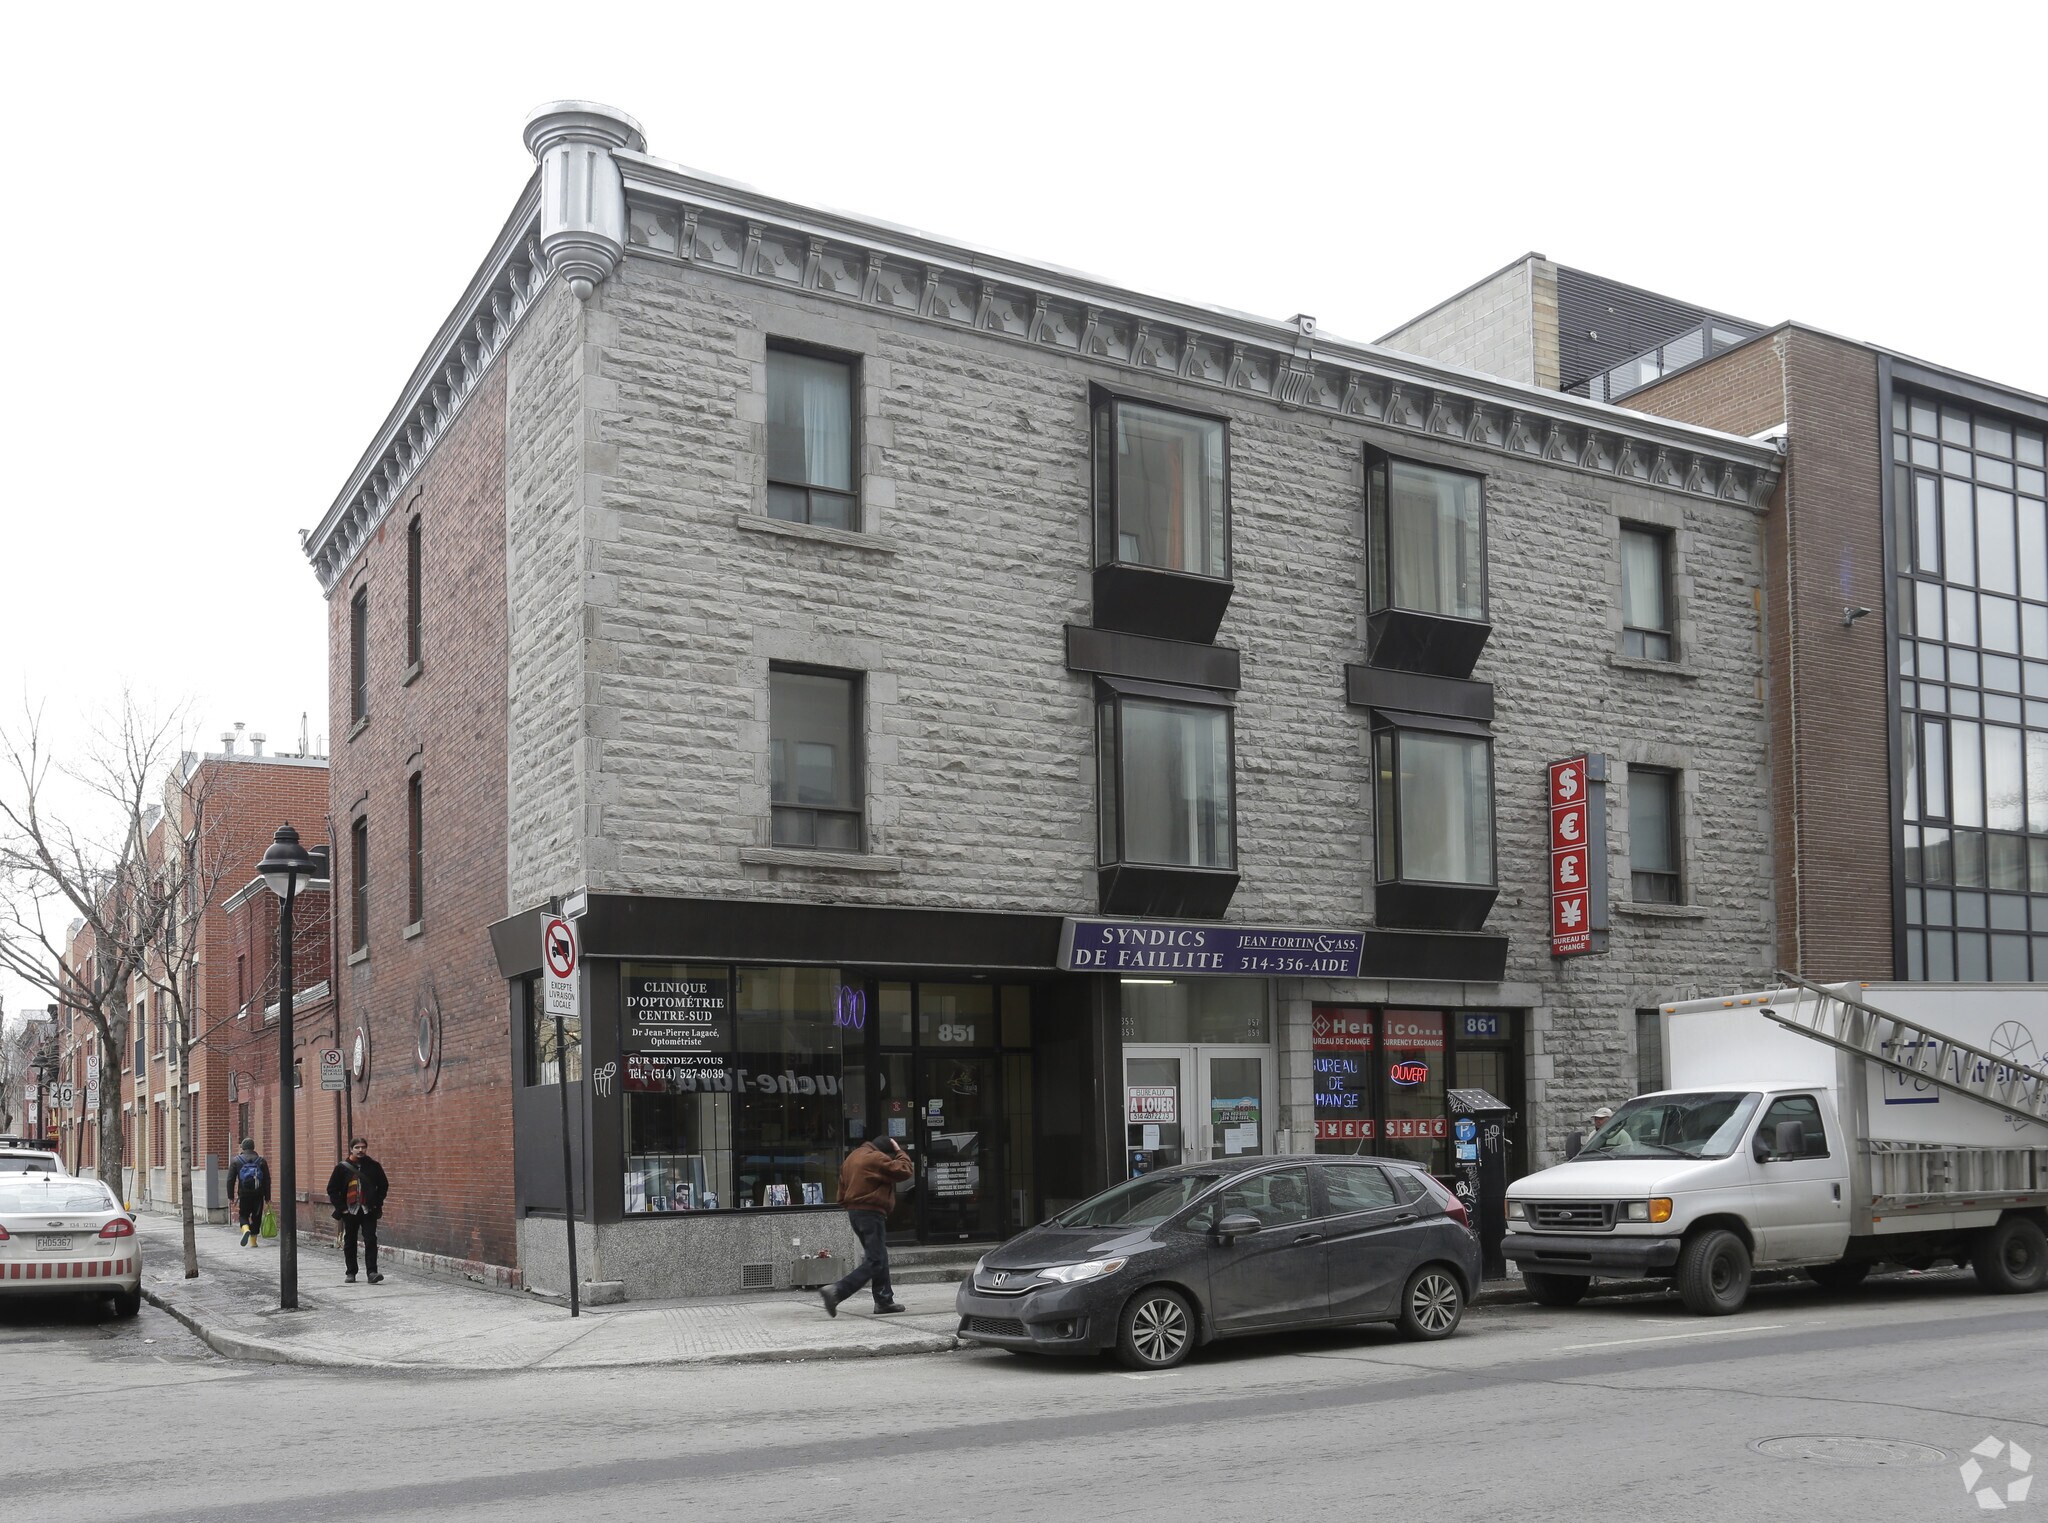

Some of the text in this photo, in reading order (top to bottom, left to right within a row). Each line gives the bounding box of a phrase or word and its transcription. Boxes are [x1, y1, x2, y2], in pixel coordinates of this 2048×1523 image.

[1101, 927, 1206, 947] SYNDICS
[1237, 935, 1269, 949] JEAN
[1271, 936, 1314, 949] FORTIN
[1553, 933, 1590, 945] BUREAU DE
[1559, 942, 1585, 952] CHANGE
[1075, 949, 1224, 968] DE FAILLITE
[1240, 956, 1349, 972] 514-356-AIDE
[551, 981, 572, 991] EXCEPTÉ
[643, 982, 708, 995] CLINIQUE
[549, 990, 575, 1000] LIVRAISON
[553, 999, 571, 1009] LOCALE
[626, 995, 725, 1009] D'OPTOMÉTRIE
[638, 1010, 713, 1021] CENTRE-SUD
[1467, 1018, 1496, 1033] 861
[632, 1028, 720, 1038] Dr Jean-Pierre Lagacé,
[937, 1023, 975, 1042] 851
[651, 1037, 702, 1047] Optométriste
[1313, 1037, 1334, 1045] UREAU
[1345, 1038, 1371, 1046] CHANGE
[1413, 1039, 1443, 1047] EXCHANGE
[629, 1056, 723, 1065] SUR RENDEZ-VOUS
[651, 1068, 676, 1081] (514)
[680, 1068, 724, 1079] 527-8039
[1391, 1064, 1429, 1082] OUVERT
[1328, 1076, 1344, 1091] DE
[1136, 1088, 1166, 1096] BUREAUX
[1142, 1097, 1174, 1113] LOUER
